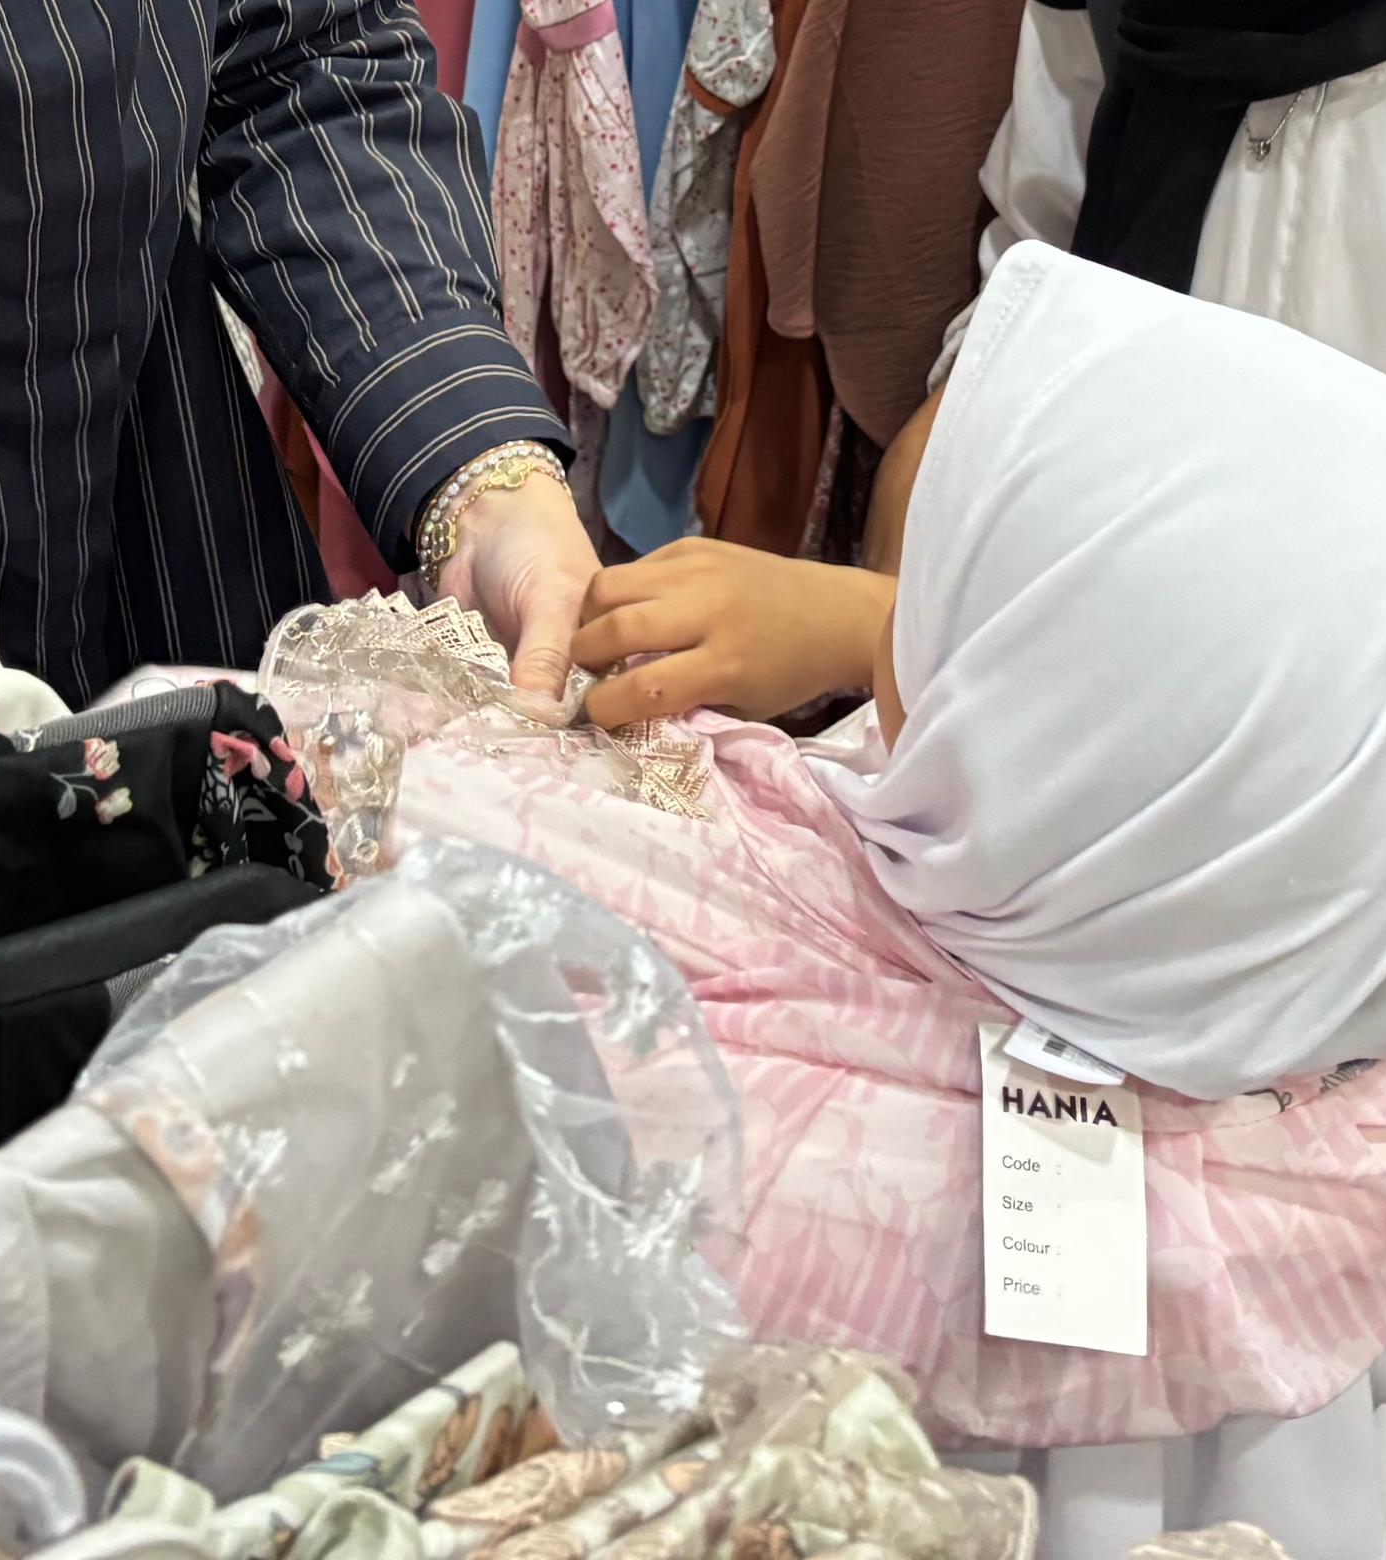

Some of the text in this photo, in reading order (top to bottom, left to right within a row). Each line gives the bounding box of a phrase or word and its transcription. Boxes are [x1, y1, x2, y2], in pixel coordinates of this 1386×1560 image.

[1002, 1085, 1118, 1127] HANIA
[1002, 1154, 1041, 1172] Code
[1002, 1195, 1034, 1212] Size
[1002, 1236, 1051, 1255] Colour
[1003, 1276, 1041, 1296] Price
